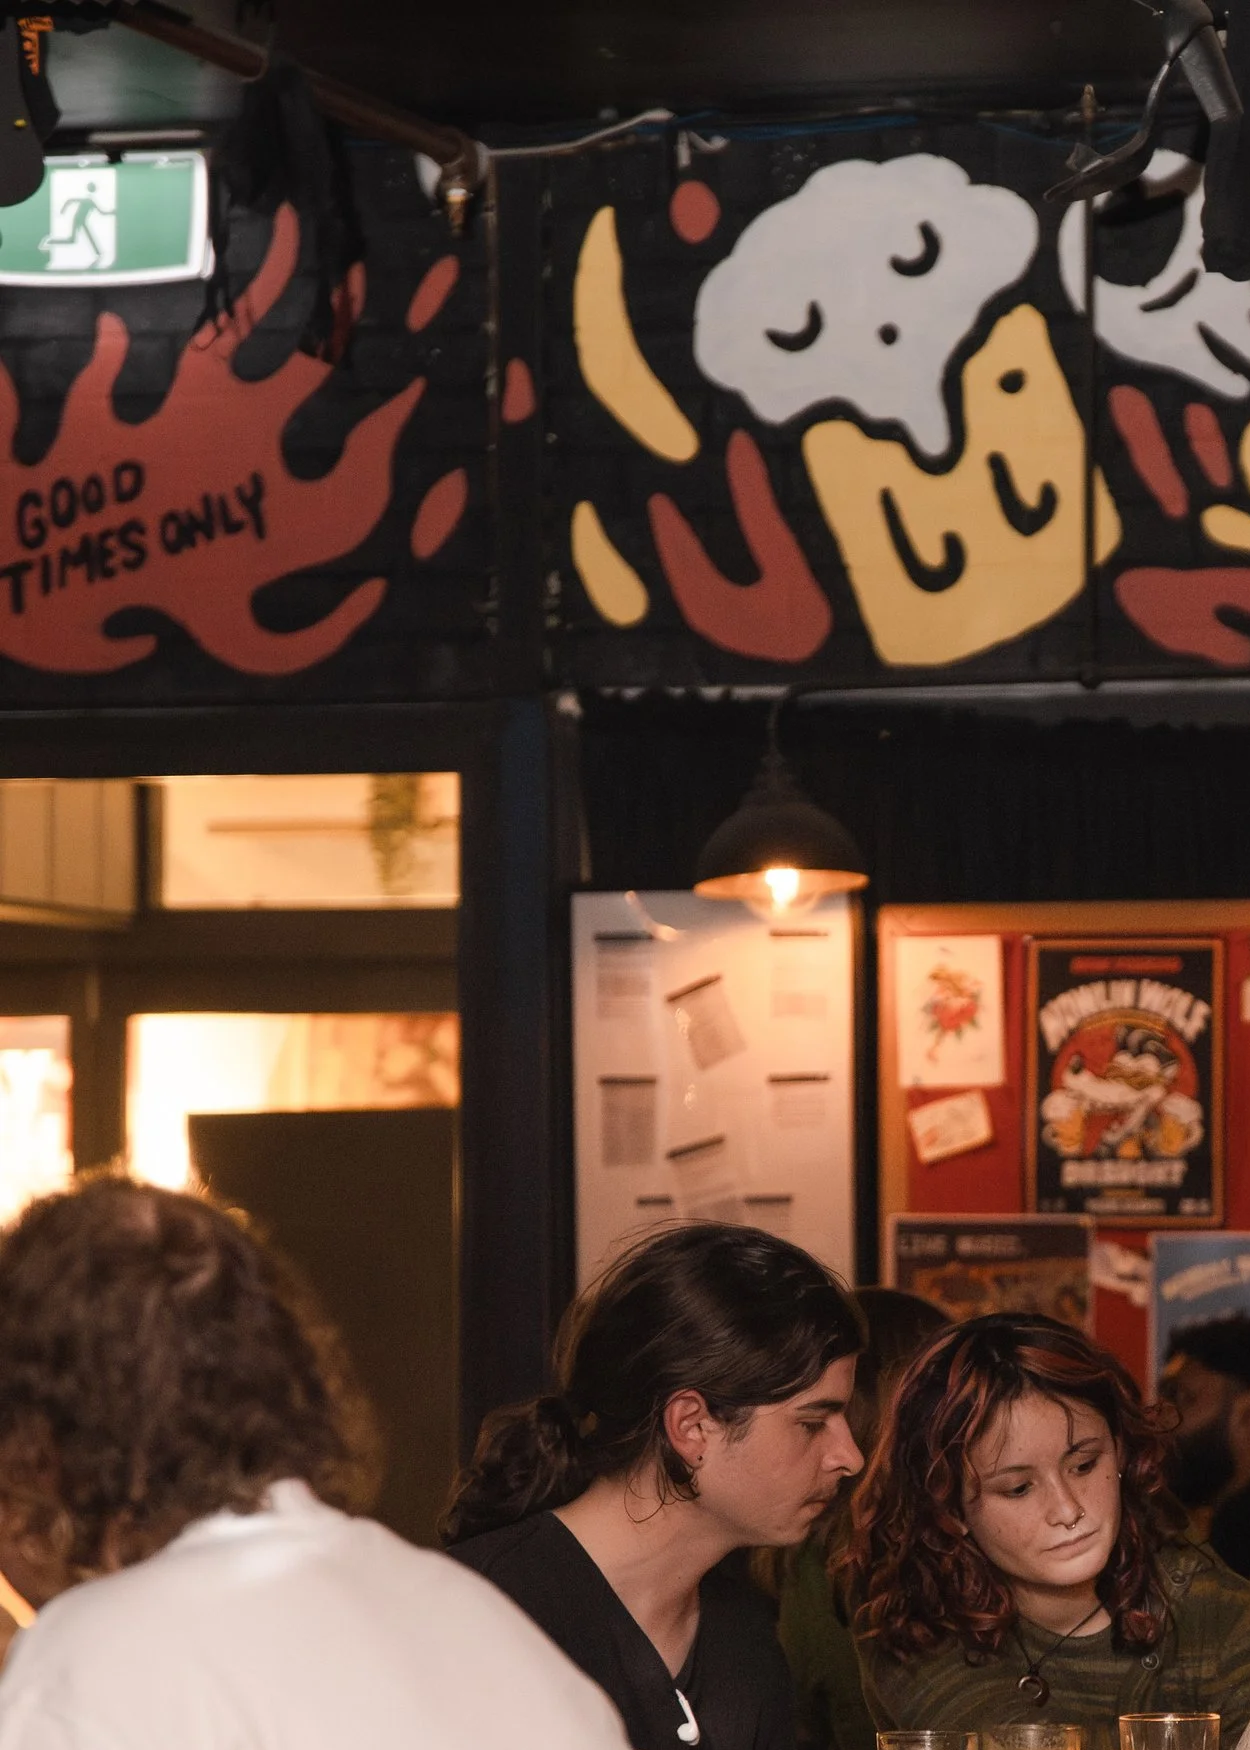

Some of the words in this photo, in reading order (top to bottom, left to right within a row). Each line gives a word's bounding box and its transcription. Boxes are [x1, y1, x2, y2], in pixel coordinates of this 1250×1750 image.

[0, 519, 147, 614] TIMES
[160, 470, 266, 555] ONLY
[16, 460, 145, 549] GOOD
